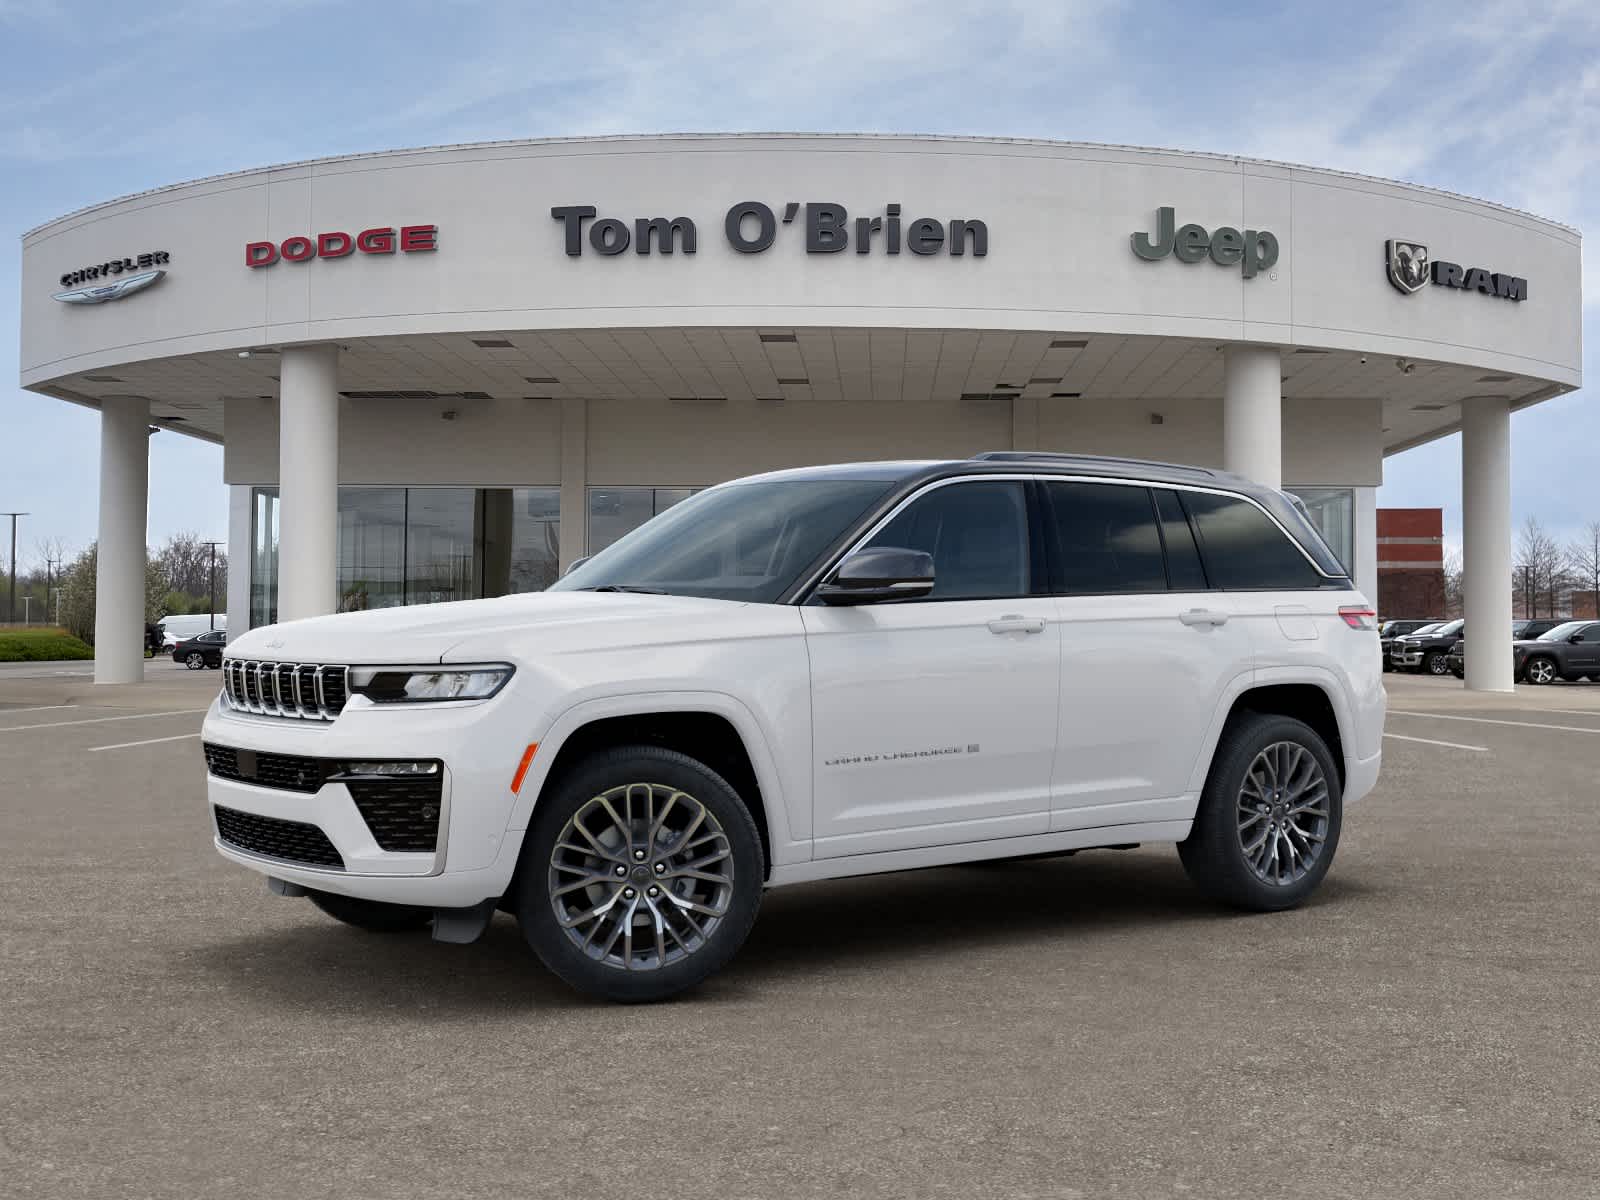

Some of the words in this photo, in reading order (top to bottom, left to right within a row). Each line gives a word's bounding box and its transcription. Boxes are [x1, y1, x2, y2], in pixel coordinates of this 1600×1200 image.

[246, 224, 437, 270] DODGE
[551, 205, 697, 257] Tom
[1131, 206, 1279, 279] Jeep
[60, 250, 169, 287] CHRYSLER
[1431, 260, 1527, 302] RAM
